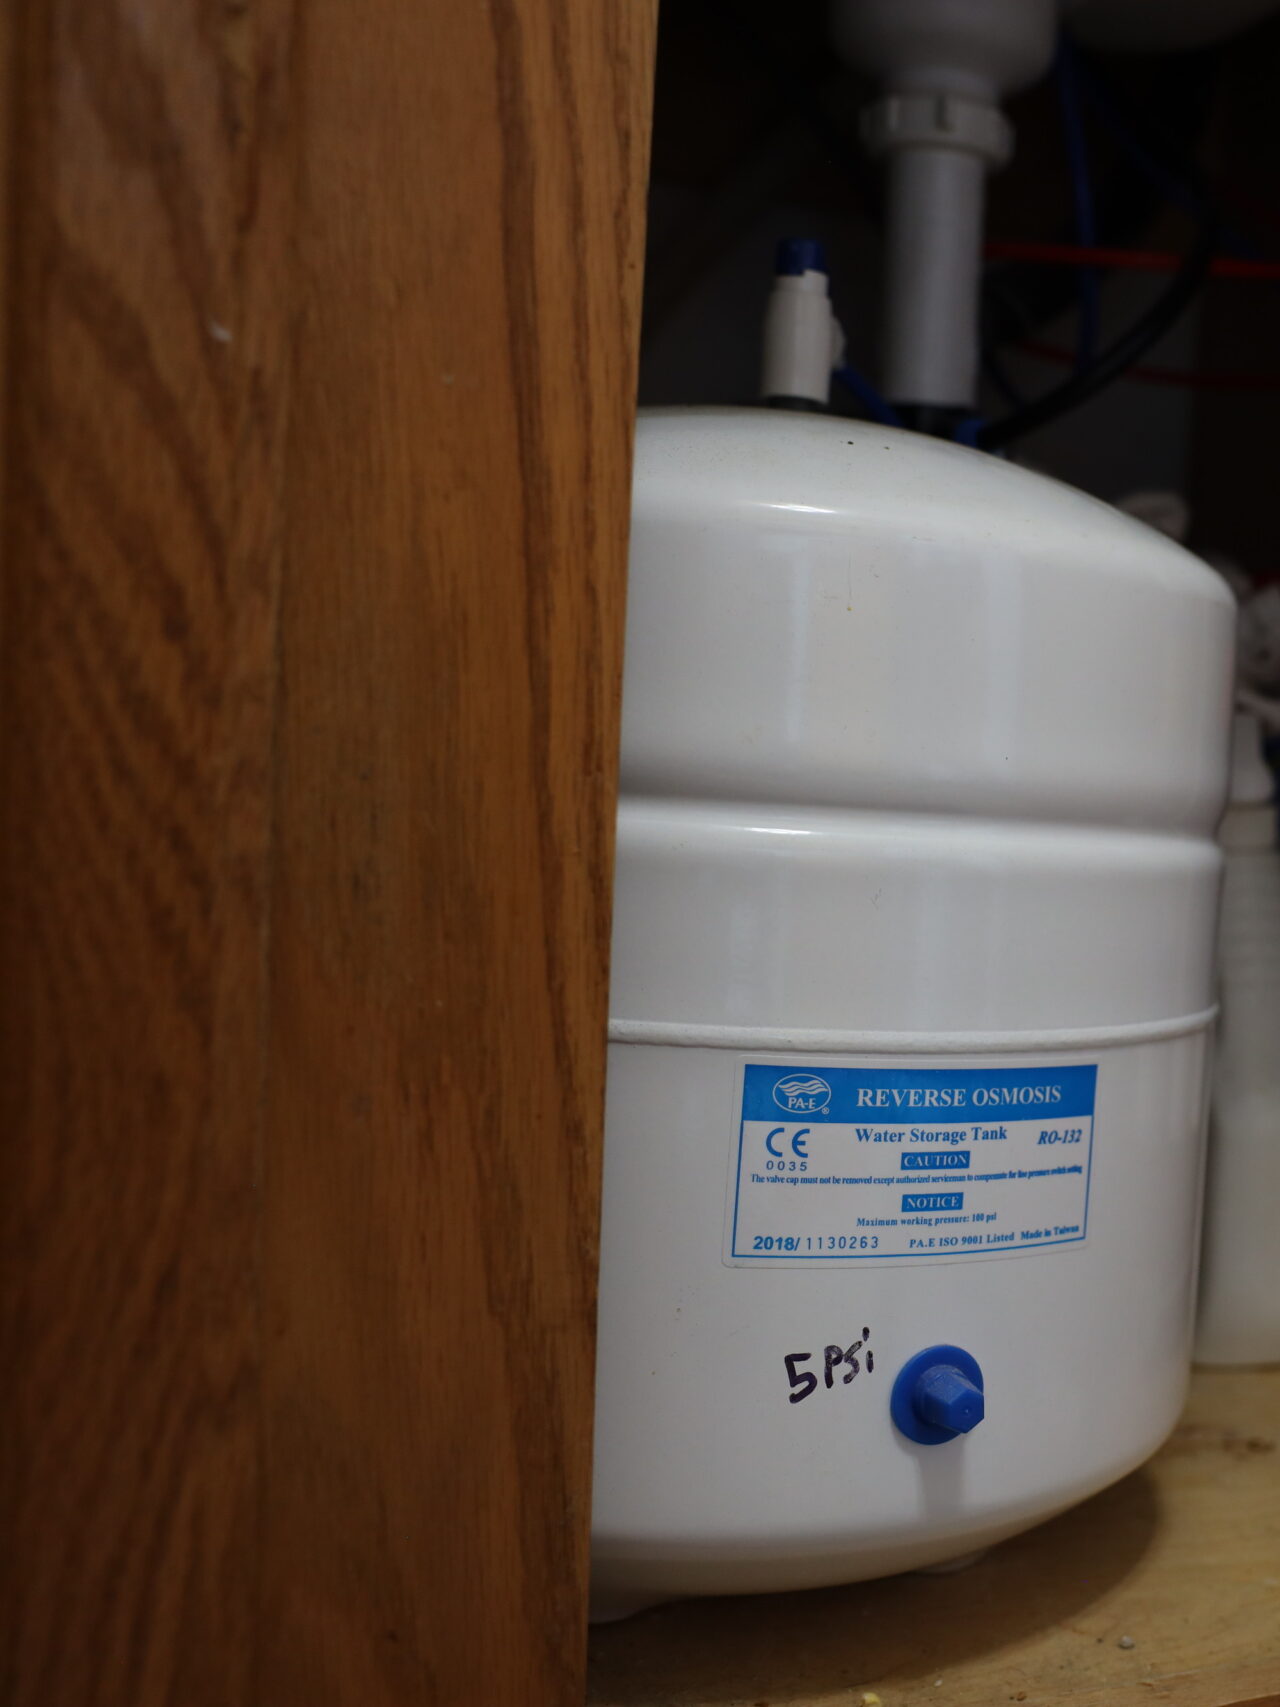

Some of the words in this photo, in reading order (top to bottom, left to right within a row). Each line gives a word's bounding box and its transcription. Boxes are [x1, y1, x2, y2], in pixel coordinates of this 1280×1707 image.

[788, 1097, 816, 1109] PA-E
[856, 1088, 966, 1107] REVERSE
[972, 1085, 1061, 1106] OSMOSIS
[766, 1127, 810, 1158] CE
[855, 1127, 905, 1143] Water
[910, 1127, 966, 1145] Storage
[971, 1126, 1007, 1140] Tank
[1037, 1129, 1082, 1144] RO-132
[766, 1161, 807, 1171] 0035
[903, 1154, 966, 1167] CAUTION
[752, 1174, 764, 1183] The
[767, 1175, 784, 1183] valve
[832, 1176, 841, 1184] be
[842, 1176, 872, 1184] removed
[873, 1177, 894, 1186] except
[896, 1174, 929, 1183] authorized
[931, 1174, 965, 1182] serviceman
[906, 1196, 960, 1209] NOTICE
[857, 1218, 897, 1227] Maximum
[900, 1217, 932, 1226] working
[935, 1215, 969, 1225] pressure:
[986, 1213, 996, 1222] psi
[1021, 1230, 1042, 1240] Made
[1044, 1229, 1051, 1237] in
[1054, 1226, 1079, 1235] Taiwan
[909, 1238, 935, 1248] PA.E
[939, 1237, 958, 1246] ISO
[962, 1235, 983, 1245] 9001
[987, 1233, 1014, 1243] Listed
